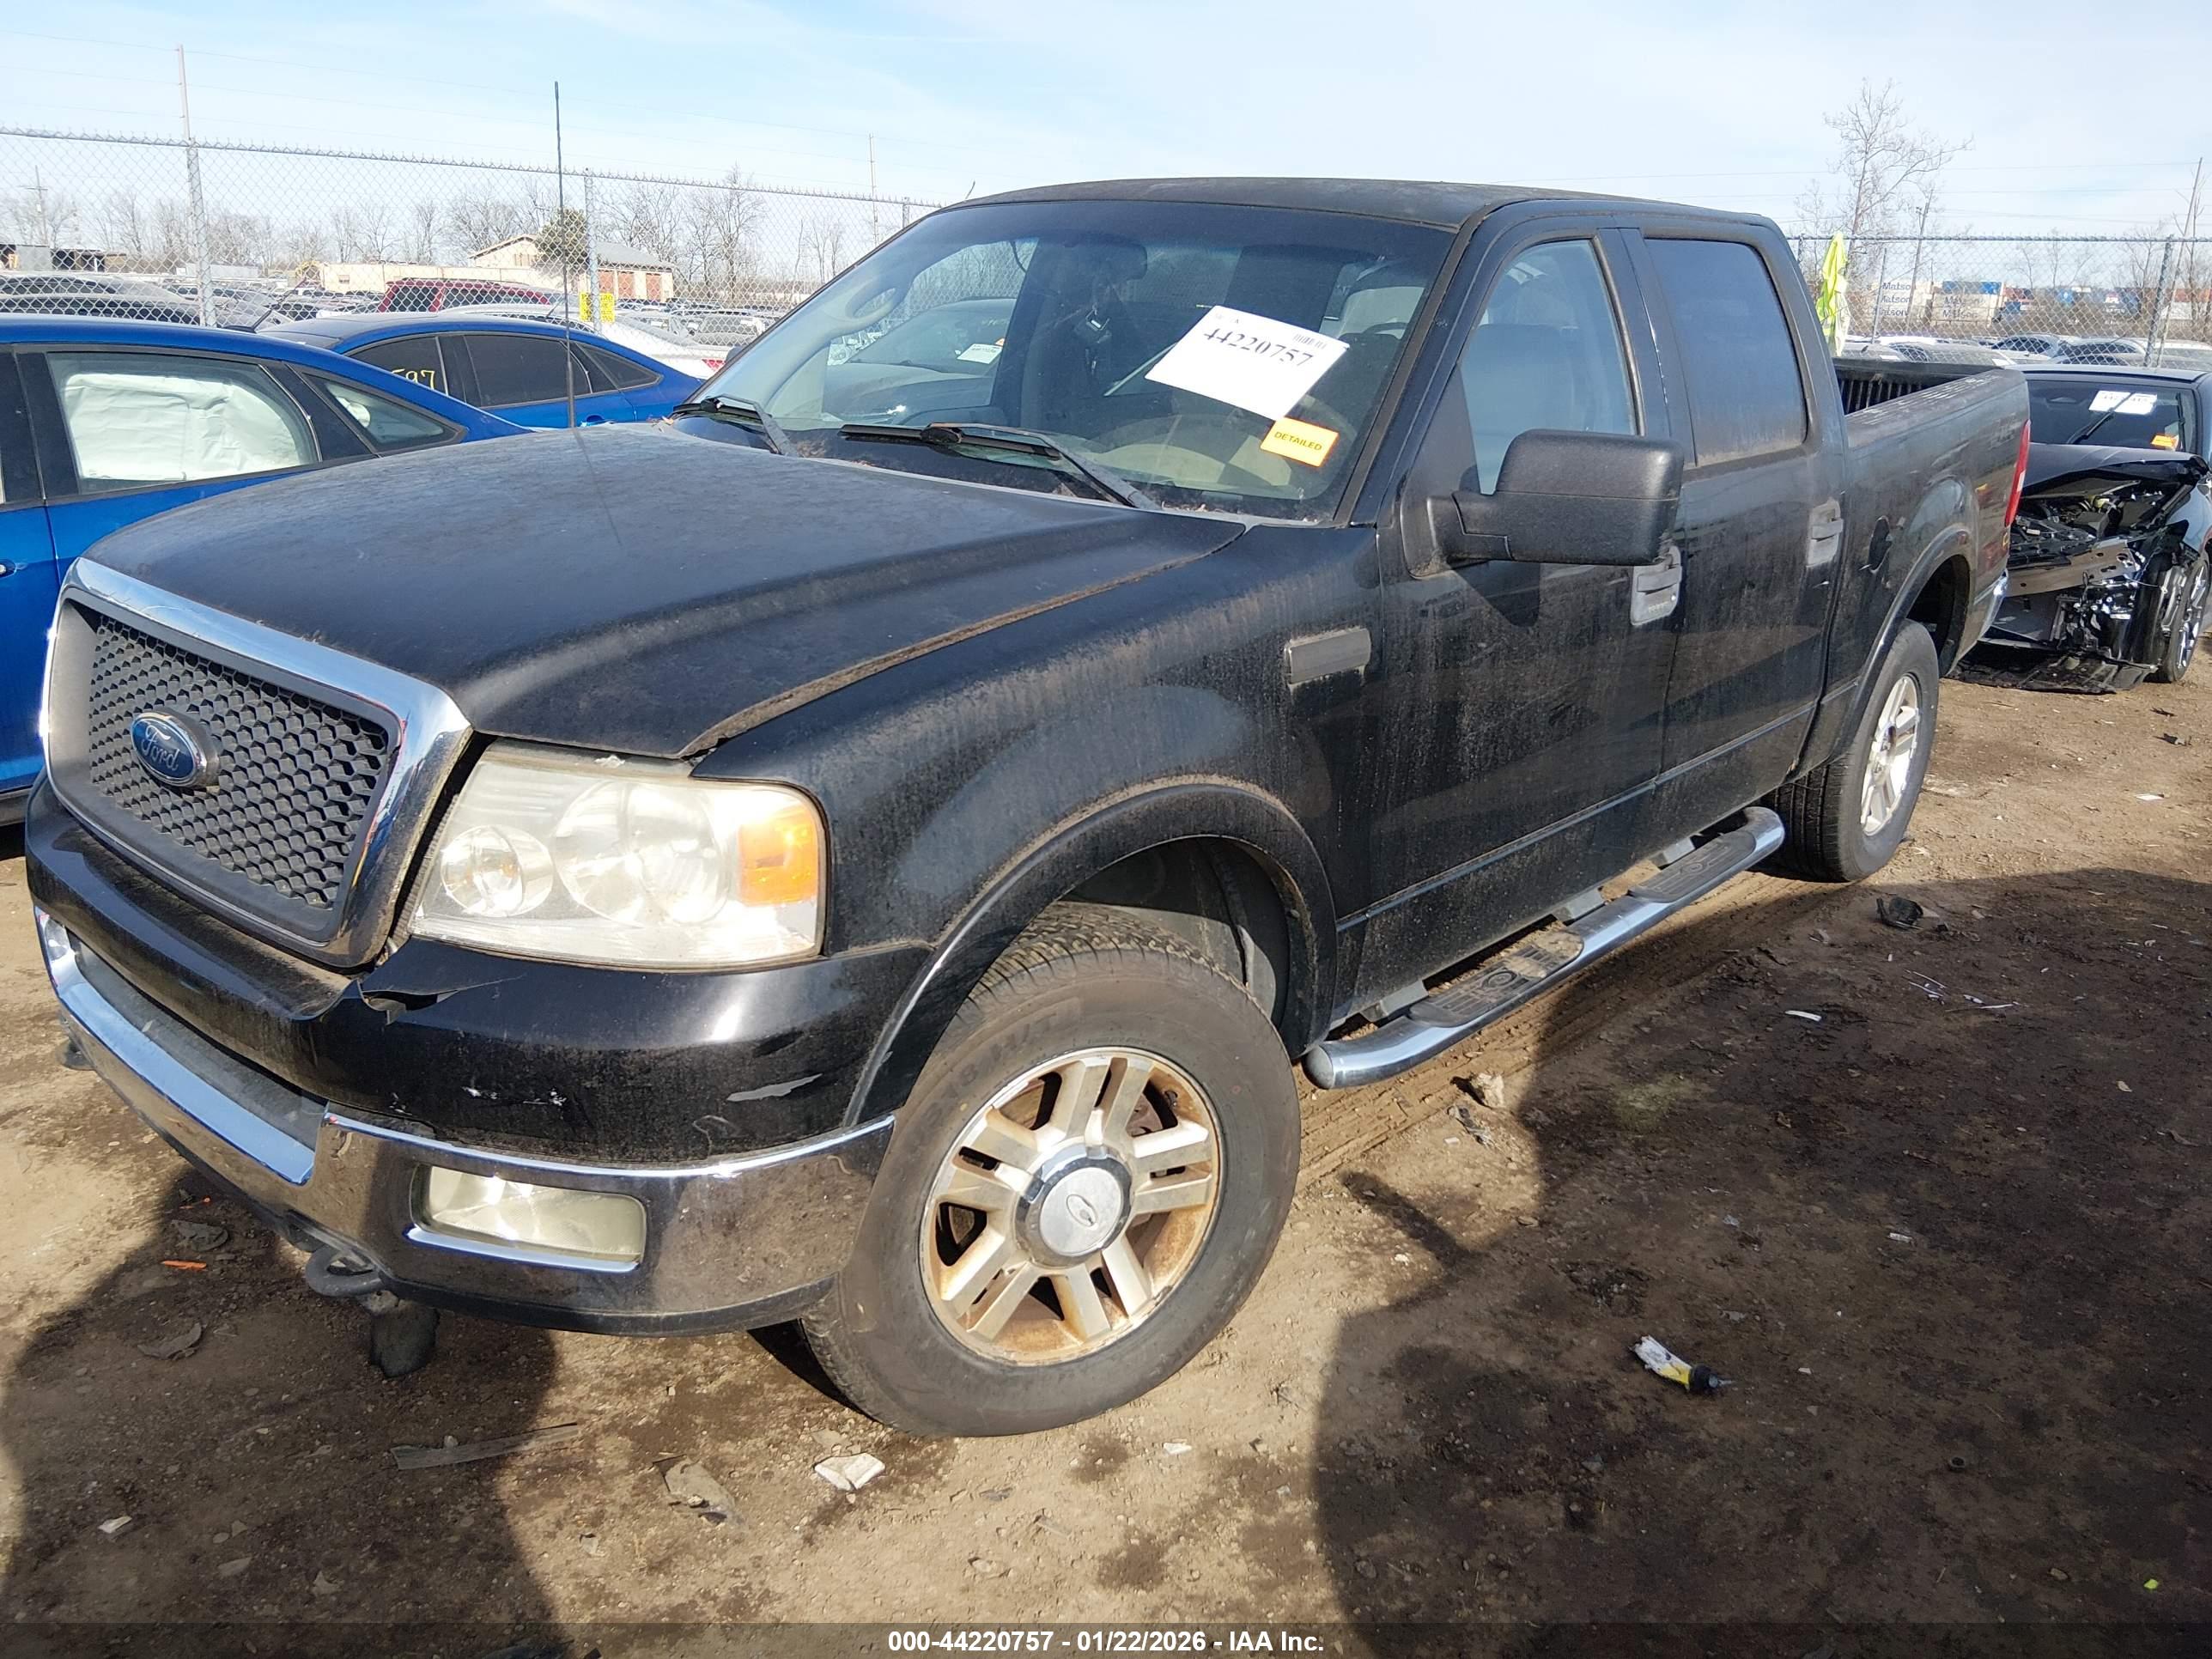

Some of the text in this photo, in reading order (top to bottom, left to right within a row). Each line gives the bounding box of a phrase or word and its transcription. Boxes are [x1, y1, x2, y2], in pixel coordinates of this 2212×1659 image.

[1881, 282, 1912, 290] Matso
[1204, 328, 1314, 367] 44220757
[1274, 431, 1322, 451] DETAILED
[141, 725, 180, 771] Ford
